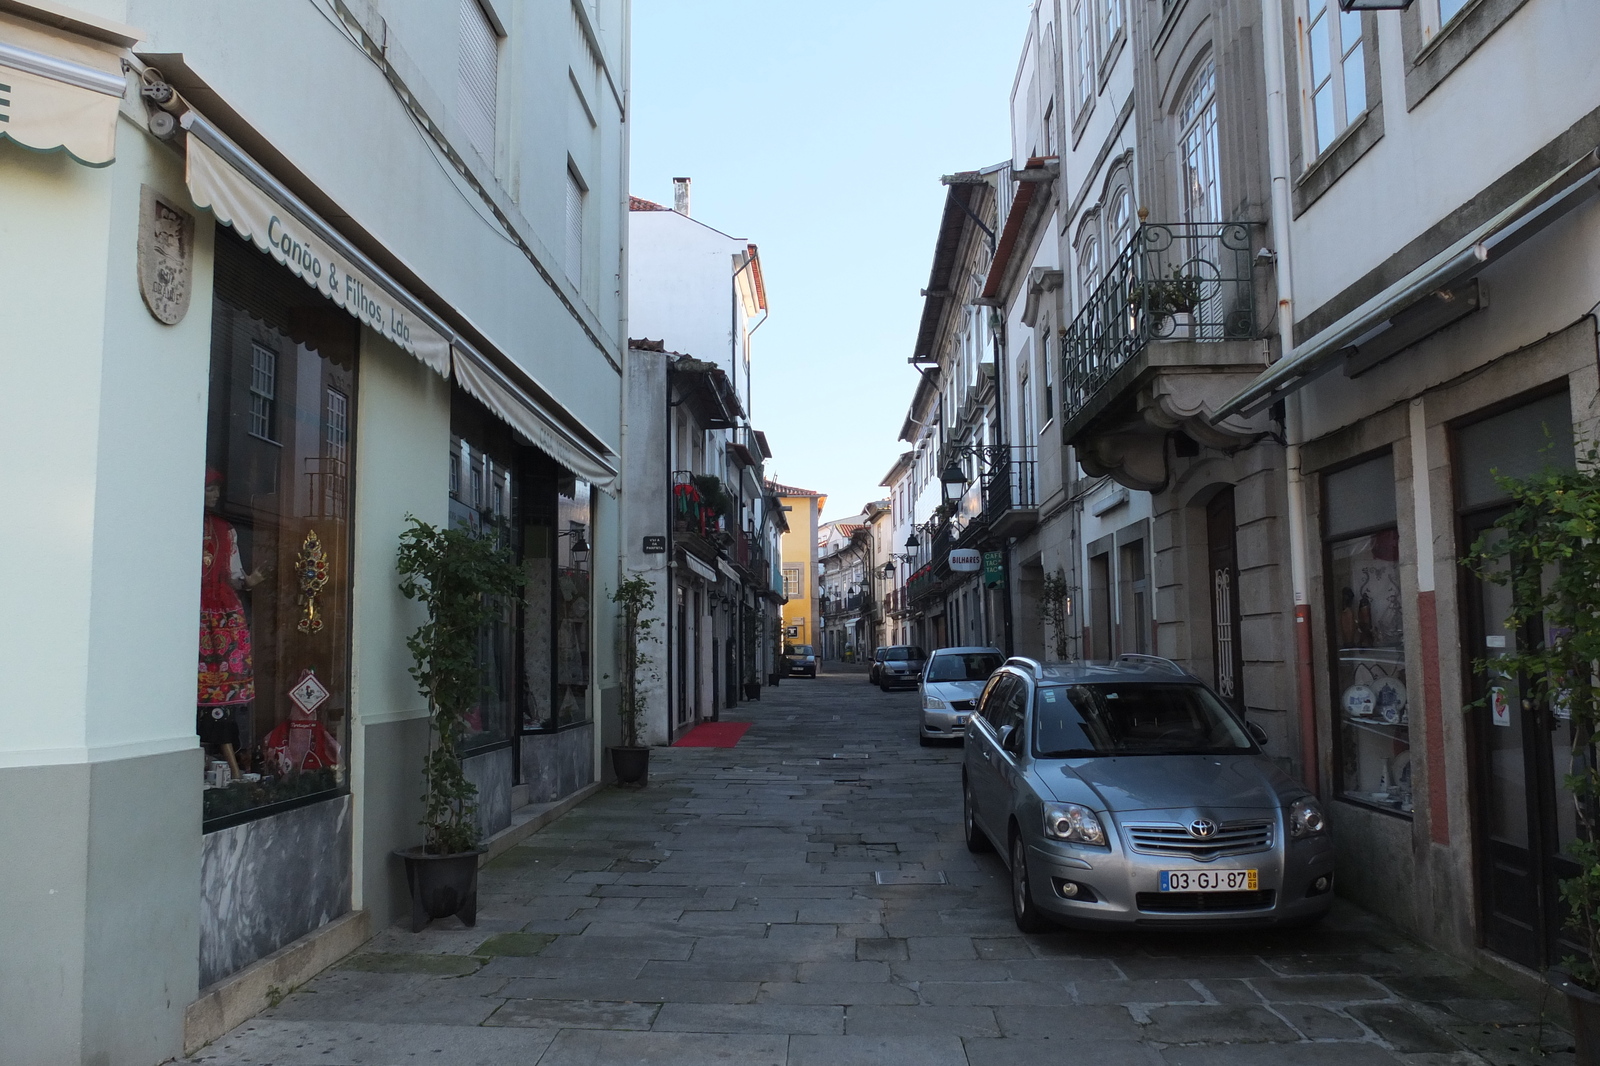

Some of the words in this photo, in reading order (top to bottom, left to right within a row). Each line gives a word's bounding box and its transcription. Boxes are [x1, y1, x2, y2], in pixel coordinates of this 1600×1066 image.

[268, 215, 321, 278] Canão
[329, 262, 339, 293] &
[346, 274, 384, 330] Filhos,
[391, 308, 413, 345] Lda.
